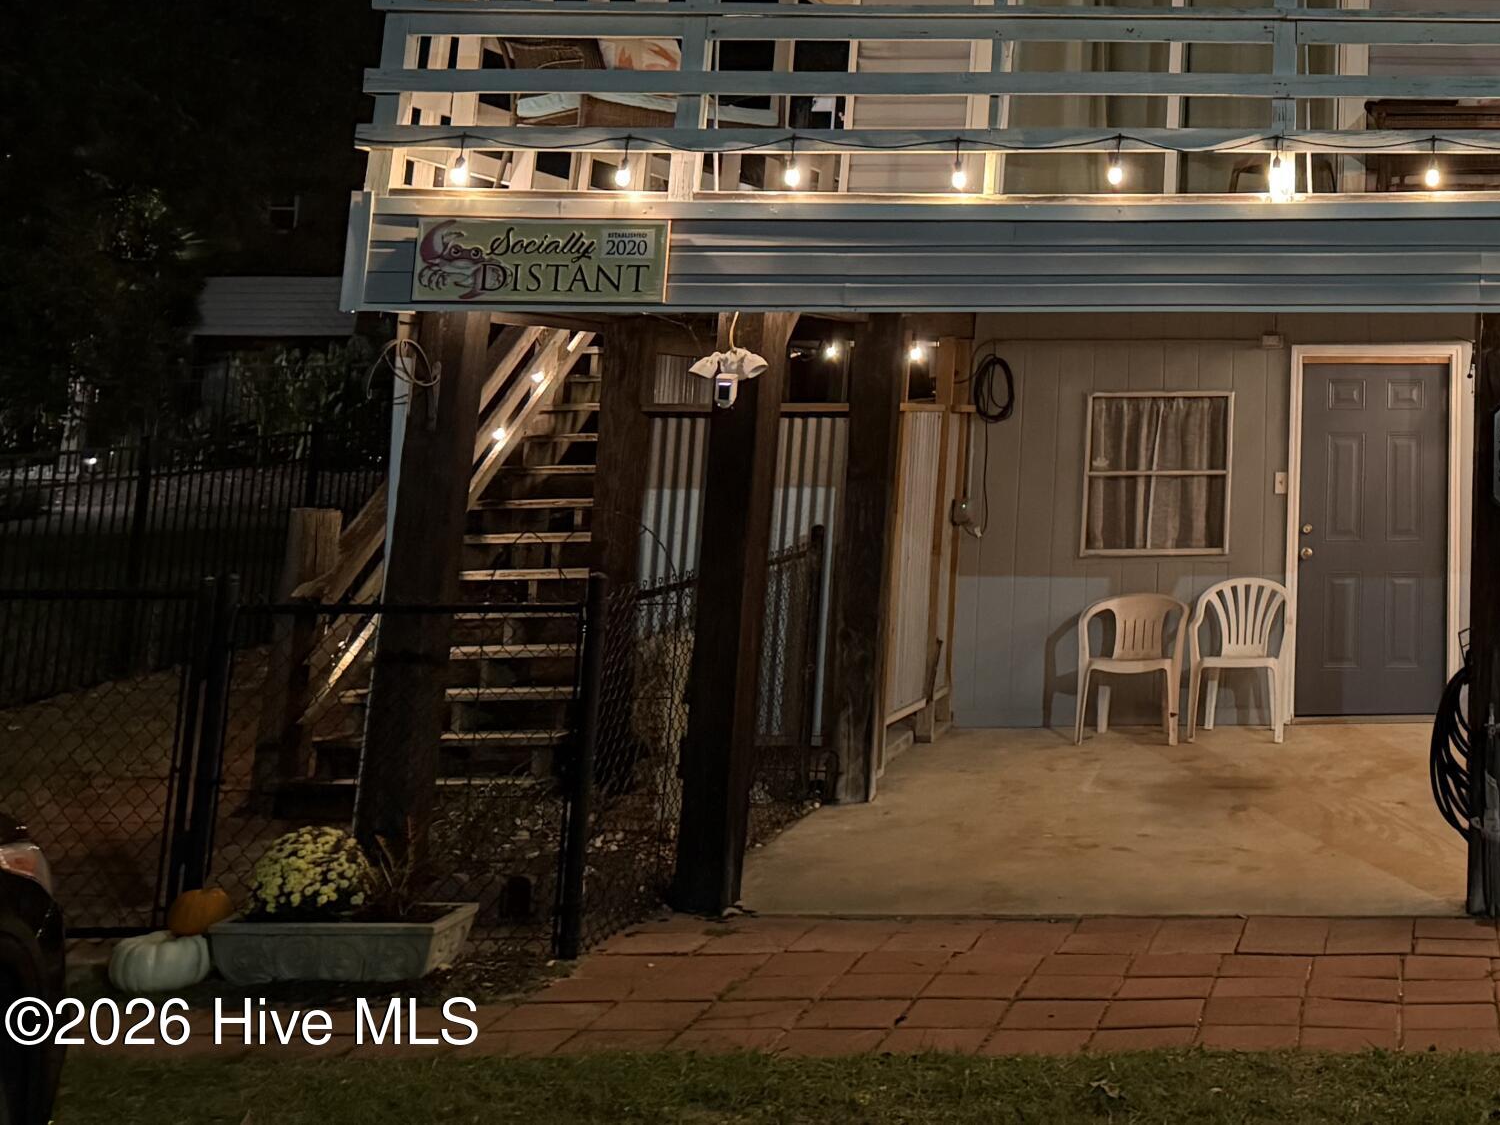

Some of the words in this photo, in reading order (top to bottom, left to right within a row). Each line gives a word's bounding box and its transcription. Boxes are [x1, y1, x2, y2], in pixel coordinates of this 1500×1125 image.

[485, 227, 596, 263] Socially
[606, 239, 648, 256] 2020
[480, 263, 650, 293] DISTANT
